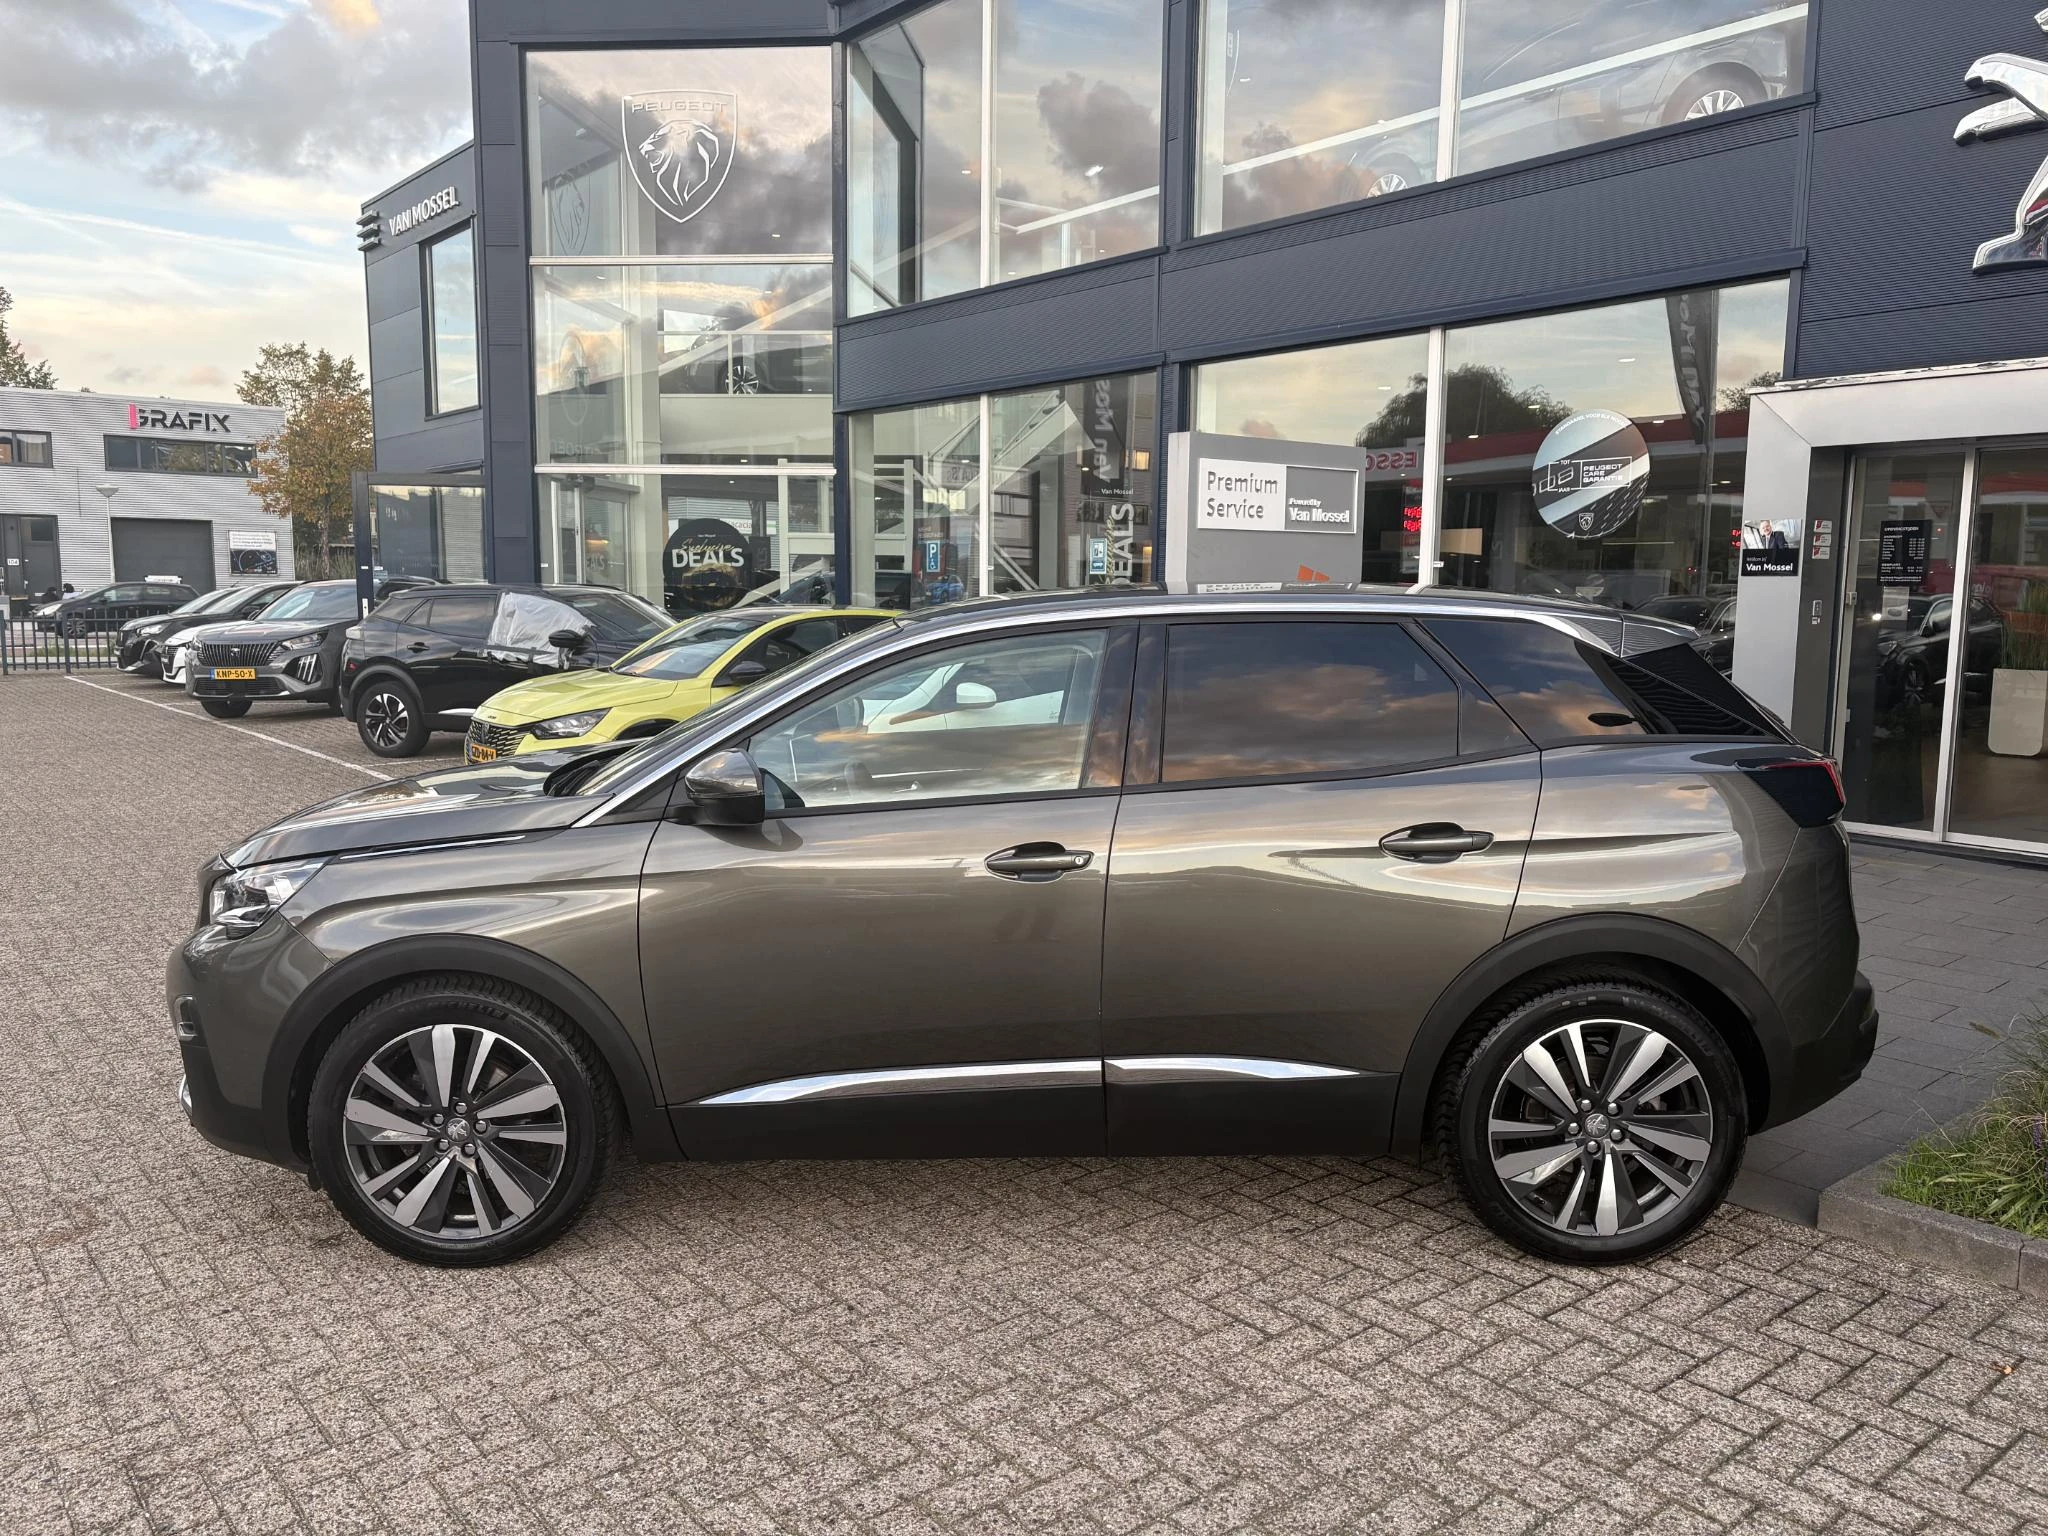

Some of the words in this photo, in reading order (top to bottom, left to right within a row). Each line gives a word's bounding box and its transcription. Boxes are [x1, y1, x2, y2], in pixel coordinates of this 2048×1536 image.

[632, 101, 728, 113] PEUGEOT
[388, 209, 412, 236] VAN
[411, 186, 459, 226] MOSSEL
[129, 404, 231, 432] GRAFIX
[1583, 463, 1623, 471] PEUGEOT
[1207, 471, 1278, 494] Premium
[1206, 497, 1264, 518] Service
[1289, 507, 1310, 521] Van
[1312, 508, 1350, 523] Mossel
[672, 547, 745, 567] DEALS
[929, 544, 937, 558] P
[1746, 563, 1761, 571] Van
[1763, 562, 1793, 571] Mossel
